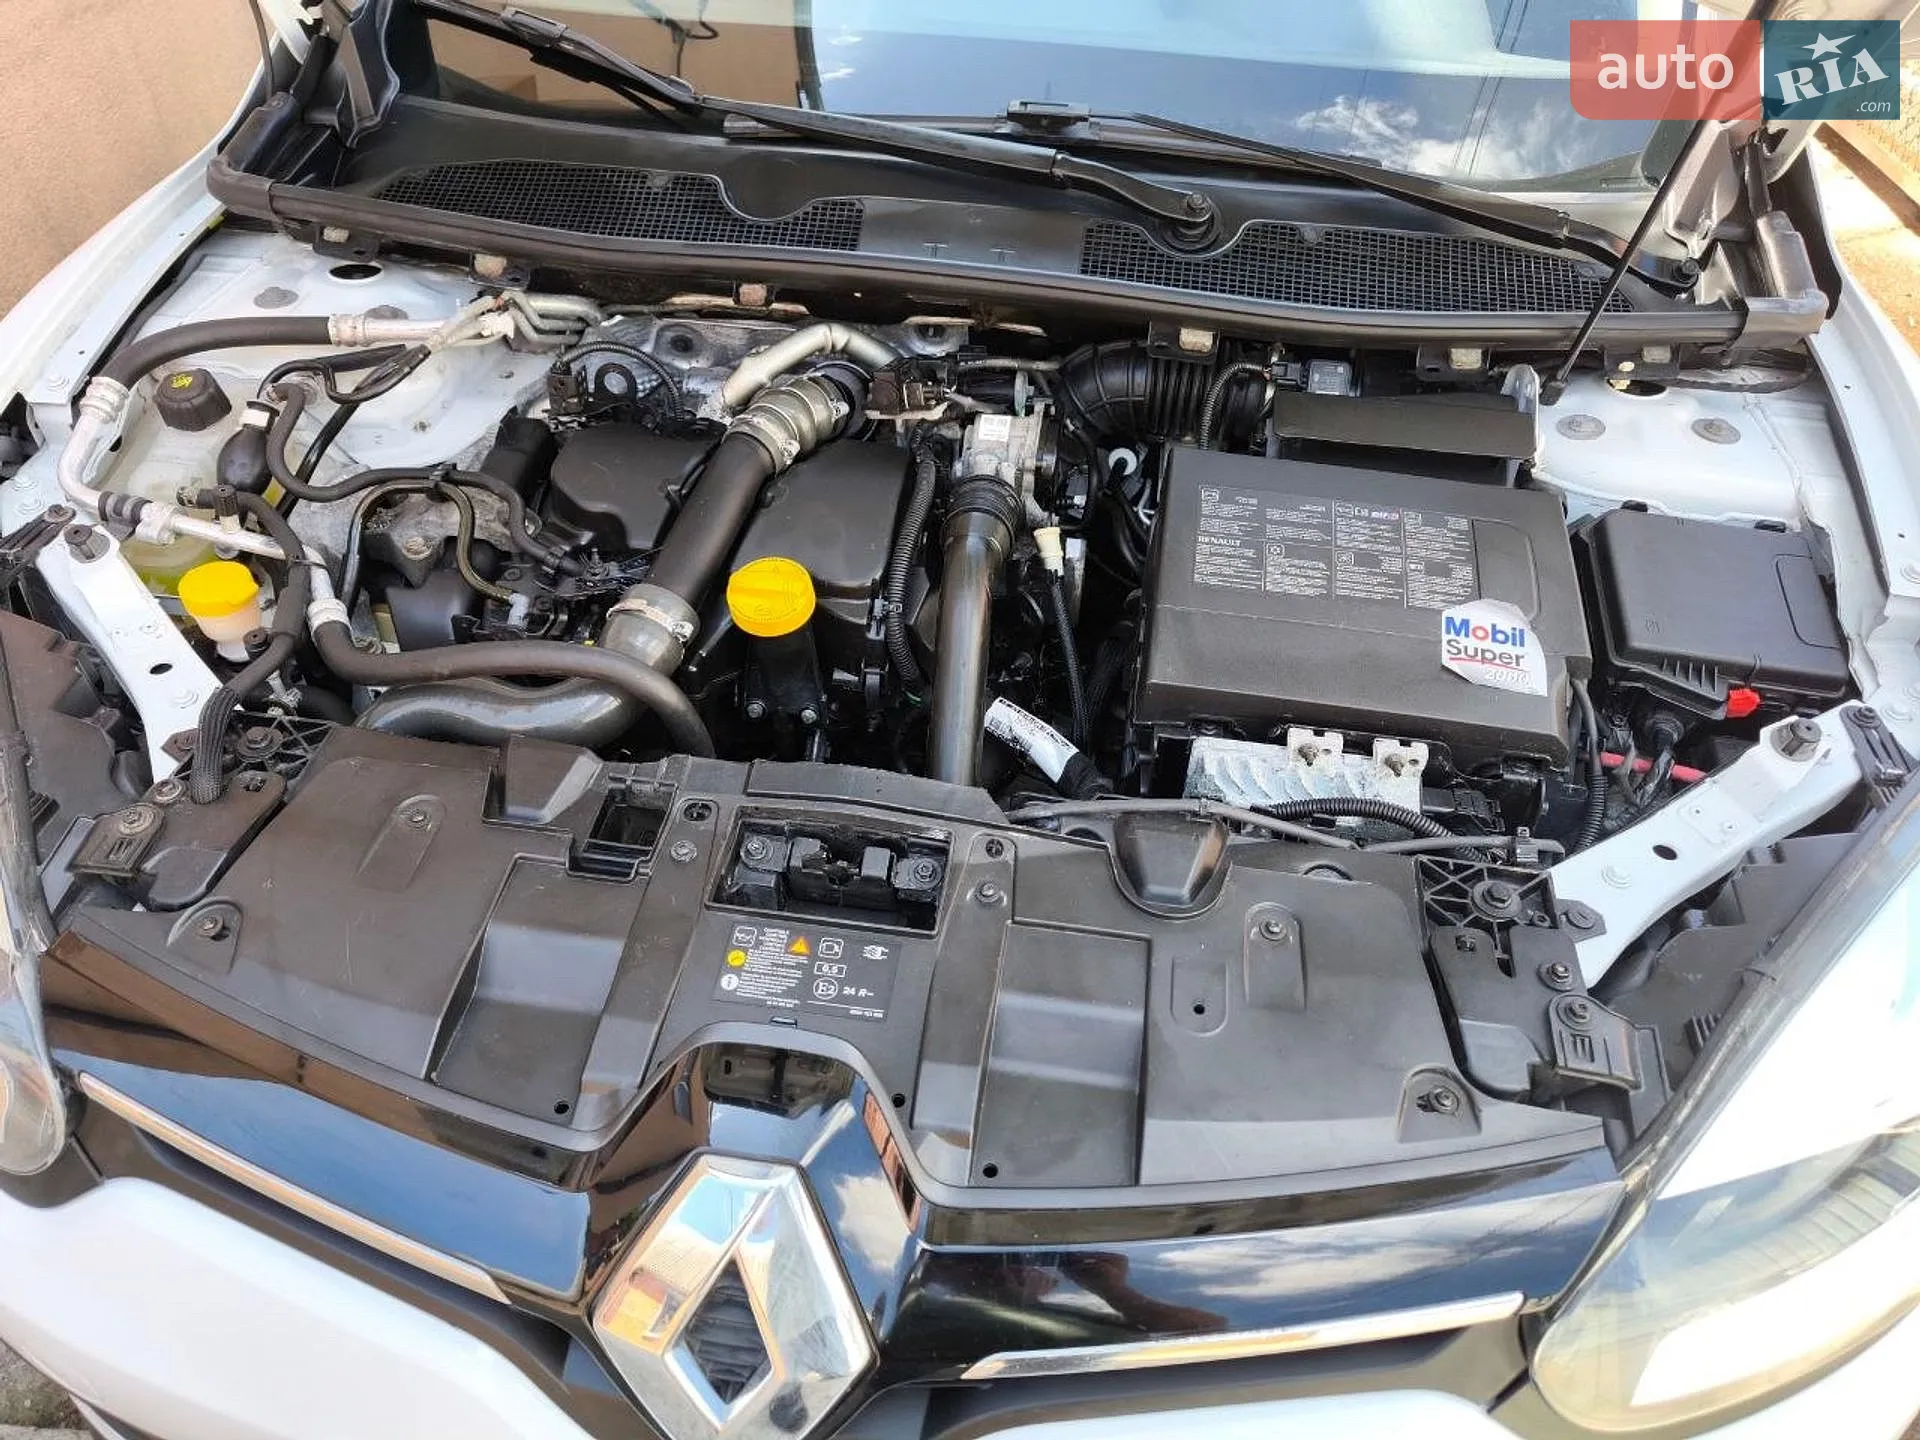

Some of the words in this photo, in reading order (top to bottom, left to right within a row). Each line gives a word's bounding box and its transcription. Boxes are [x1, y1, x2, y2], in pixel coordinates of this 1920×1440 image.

[1198, 535, 1241, 547] RENAULT
[1445, 616, 1525, 648] Mobil
[1446, 639, 1525, 667] Super
